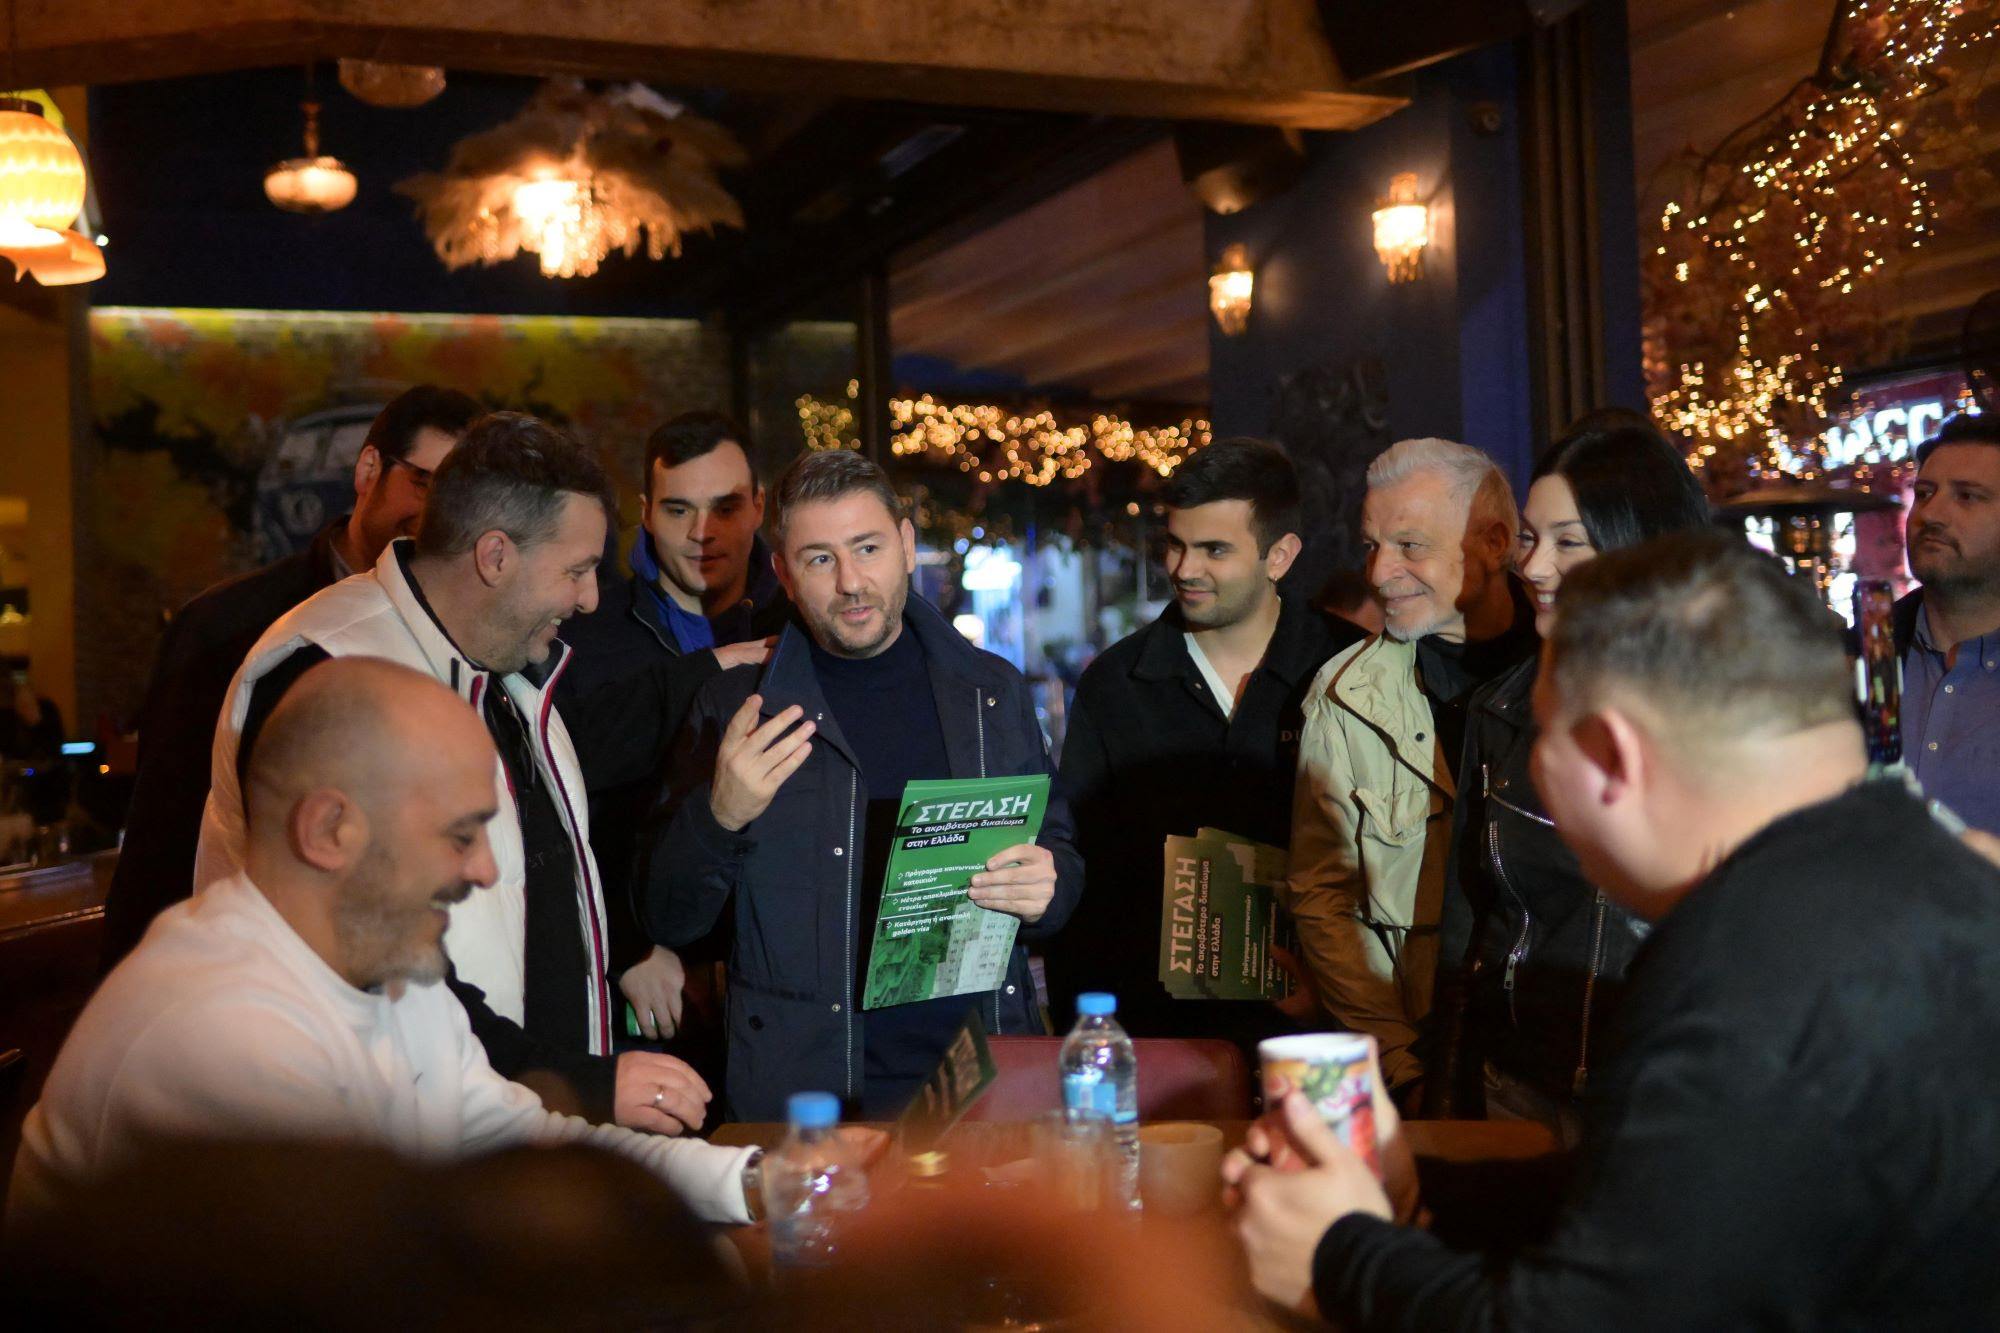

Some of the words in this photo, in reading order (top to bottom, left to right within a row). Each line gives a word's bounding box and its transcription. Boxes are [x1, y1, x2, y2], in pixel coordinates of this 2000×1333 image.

[915, 794, 1032, 822] ΣΤΕΓΑΣΗ
[924, 821, 978, 833] ακριβότερο
[981, 818, 1024, 827] δικαίωμα
[906, 840, 929, 848] στην
[931, 834, 965, 845] Ελλάδα
[905, 867, 943, 878] Πρόγραμμα
[944, 864, 986, 872] κοινωνικών
[903, 876, 938, 886] κατοικιών
[1199, 860, 1211, 904] δικαίωμα
[900, 896, 922, 904] Μέτρα
[894, 917, 932, 928] Κατάργηση
[1170, 857, 1197, 974] ΣΤΕΓΑΣΗ
[1197, 906, 1209, 961] ακριβότερο
[1211, 917, 1221, 952] Ελλάδα
[1196, 963, 1205, 975] Το
[1211, 954, 1221, 977] στην
